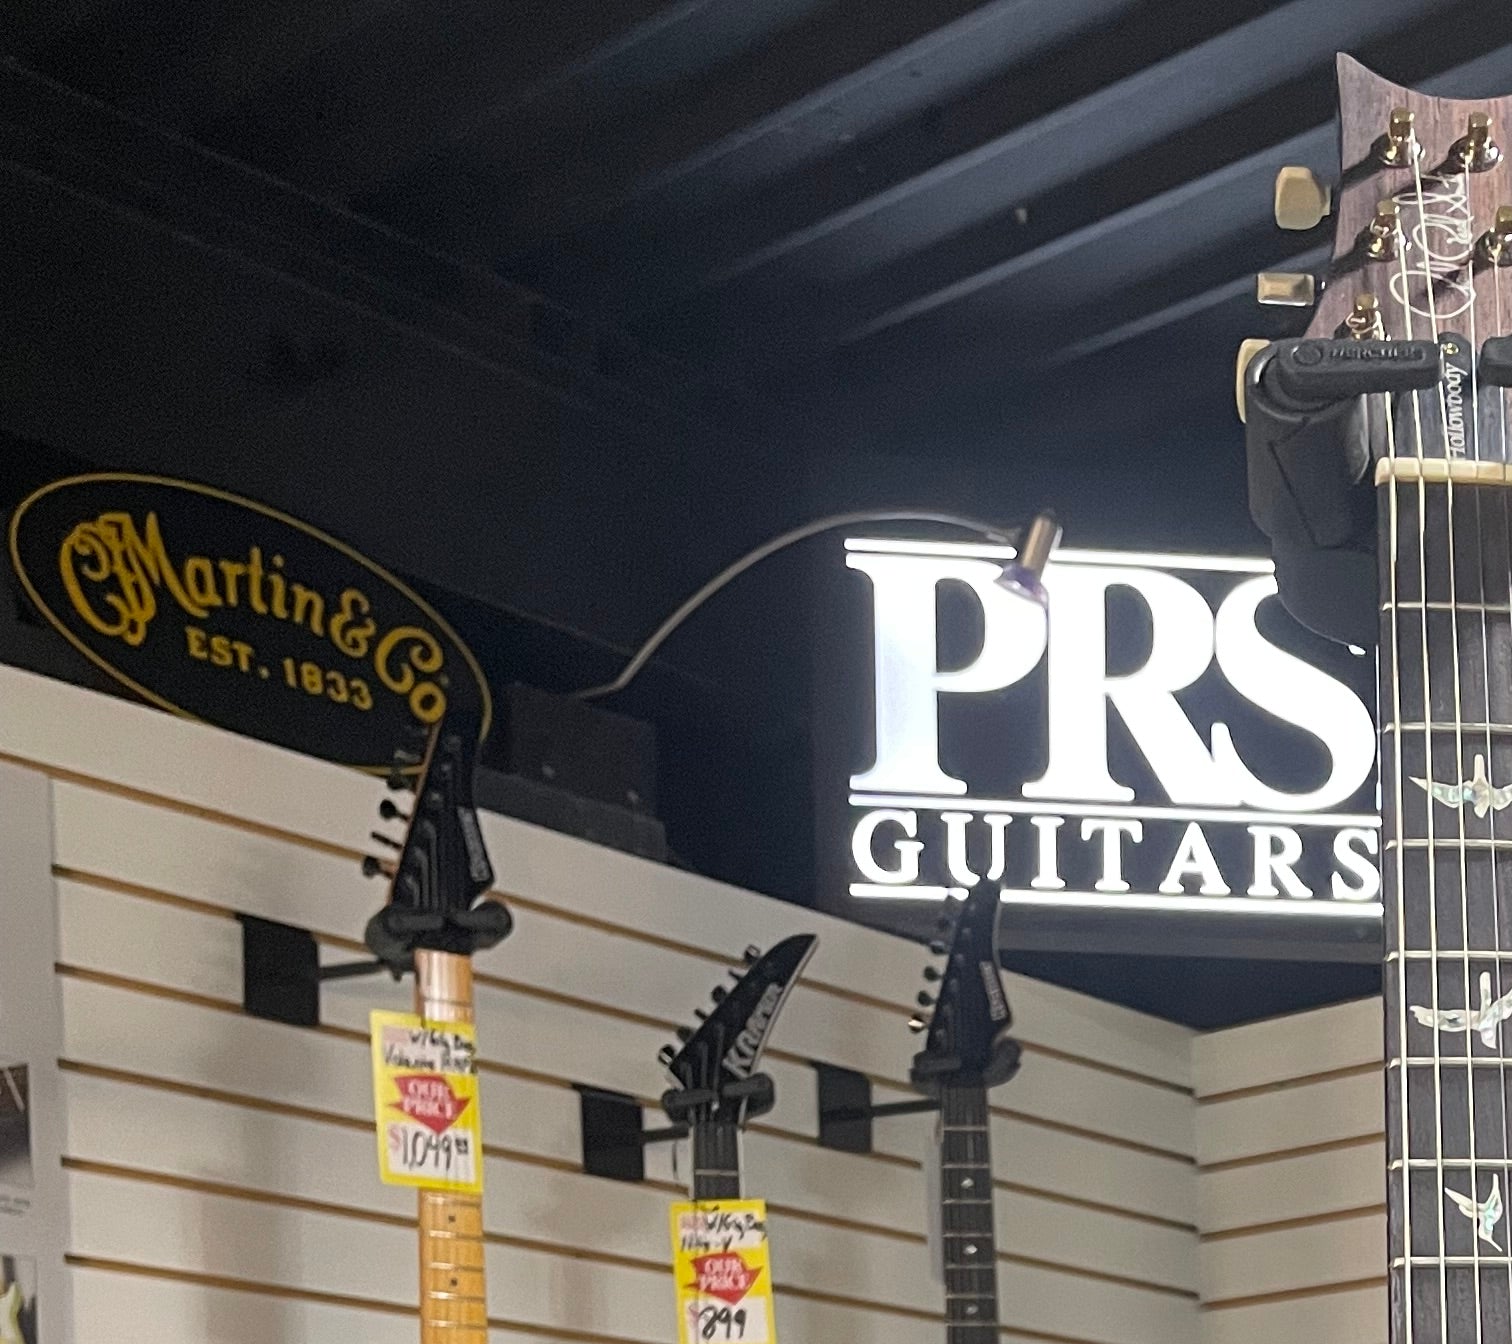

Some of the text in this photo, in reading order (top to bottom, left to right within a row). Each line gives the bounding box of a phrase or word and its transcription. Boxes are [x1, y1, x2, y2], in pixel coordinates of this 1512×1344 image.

[283, 657, 374, 711] 1833
[845, 553, 1377, 811] PRS
[850, 810, 1381, 901] GUITARS
